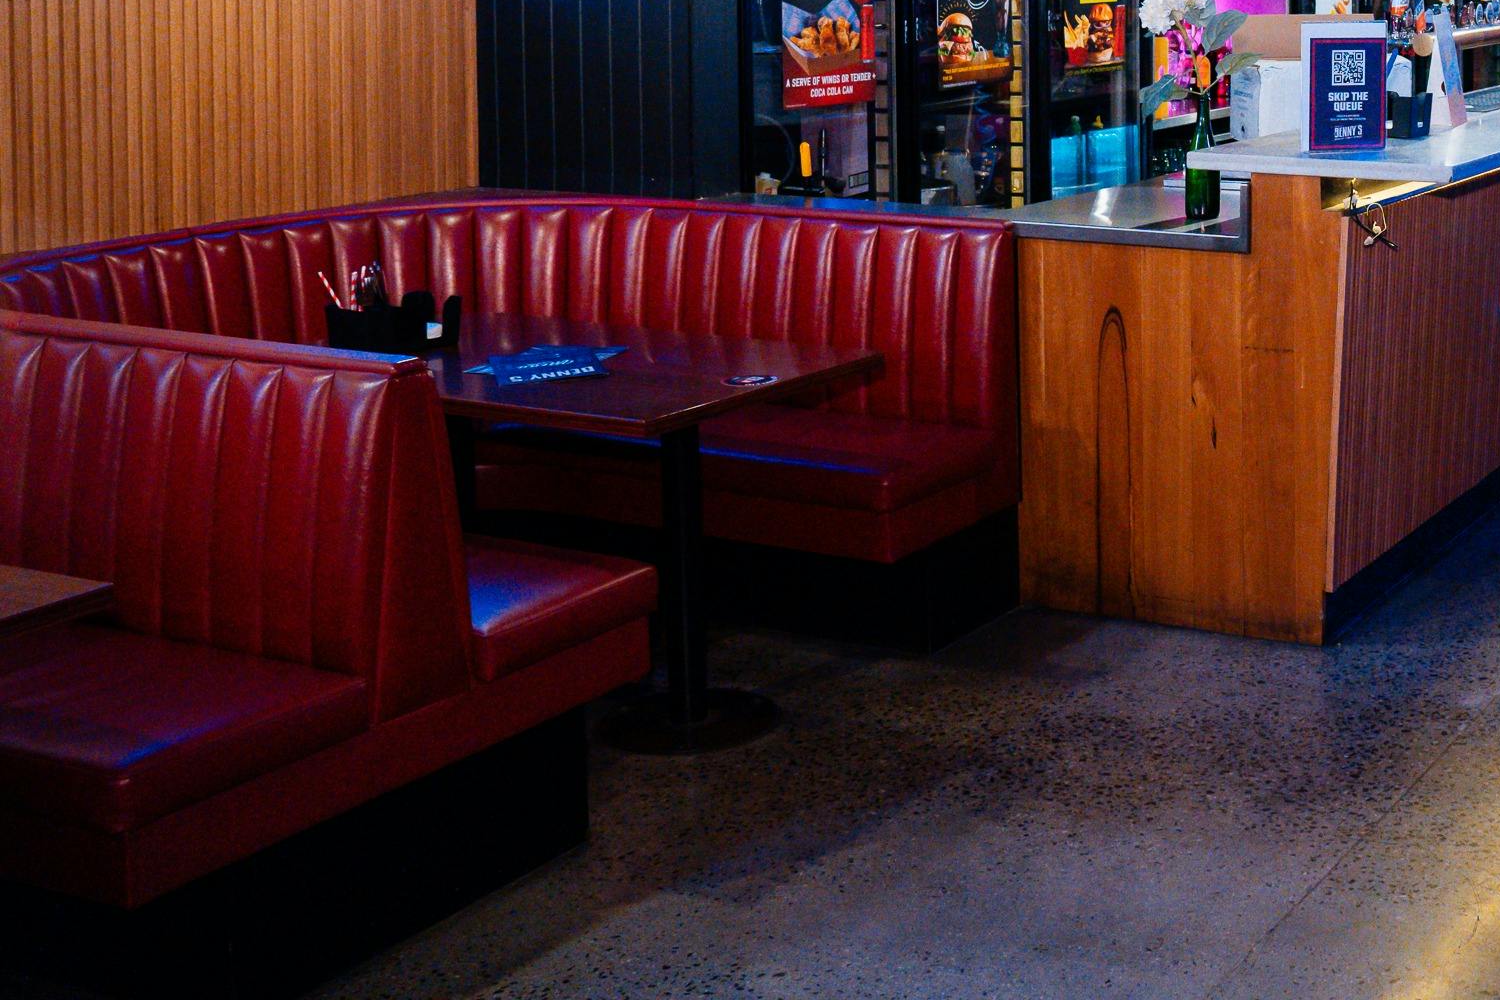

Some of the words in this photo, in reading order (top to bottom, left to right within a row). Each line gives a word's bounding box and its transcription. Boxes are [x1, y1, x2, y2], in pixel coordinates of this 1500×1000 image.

[785, 78, 791, 88] A
[791, 76, 811, 88] SERVE
[812, 76, 820, 86] OF
[821, 74, 840, 85] WINGS
[841, 73, 849, 83] OR
[850, 72, 871, 82] TENDER
[810, 87, 826, 98] COCA
[826, 86, 841, 97] COLA
[842, 85, 854, 95] CAN
[1328, 91, 1350, 101] SKIP
[1351, 91, 1369, 101] THE
[1333, 101, 1363, 112] QUEUE
